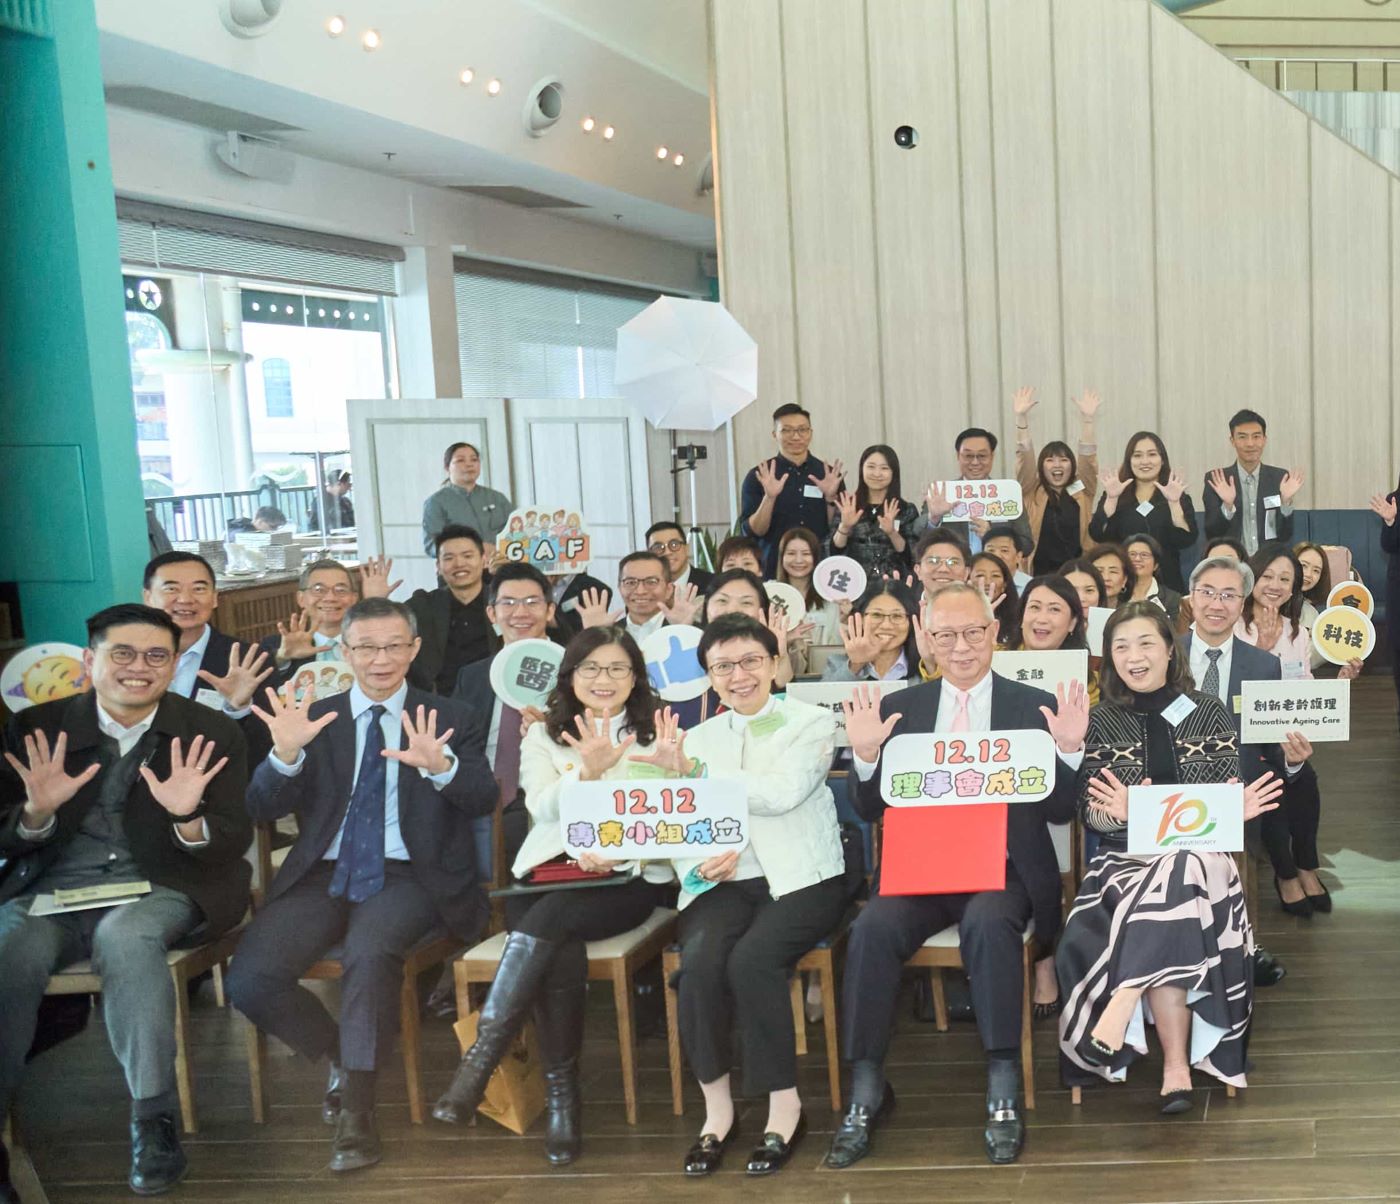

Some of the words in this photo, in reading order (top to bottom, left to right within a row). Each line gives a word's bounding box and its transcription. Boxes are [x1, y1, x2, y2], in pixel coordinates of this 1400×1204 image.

[955, 484, 998, 498] 12.12
[943, 500, 1019, 517] 事會成立
[506, 538, 584, 561] GAF
[828, 569, 851, 592] 住
[1323, 624, 1363, 649] 科技
[516, 656, 556, 692] 醫
[1016, 668, 1044, 680] 金融
[1254, 697, 1337, 712] 創新老齡護理
[1249, 717, 1290, 726] Innovative
[1292, 717, 1320, 726] Ageing
[1322, 716, 1341, 724] Care
[934, 738, 1011, 765] 12.12
[890, 766, 1047, 798] 理事會成立
[613, 787, 696, 815] 12.12
